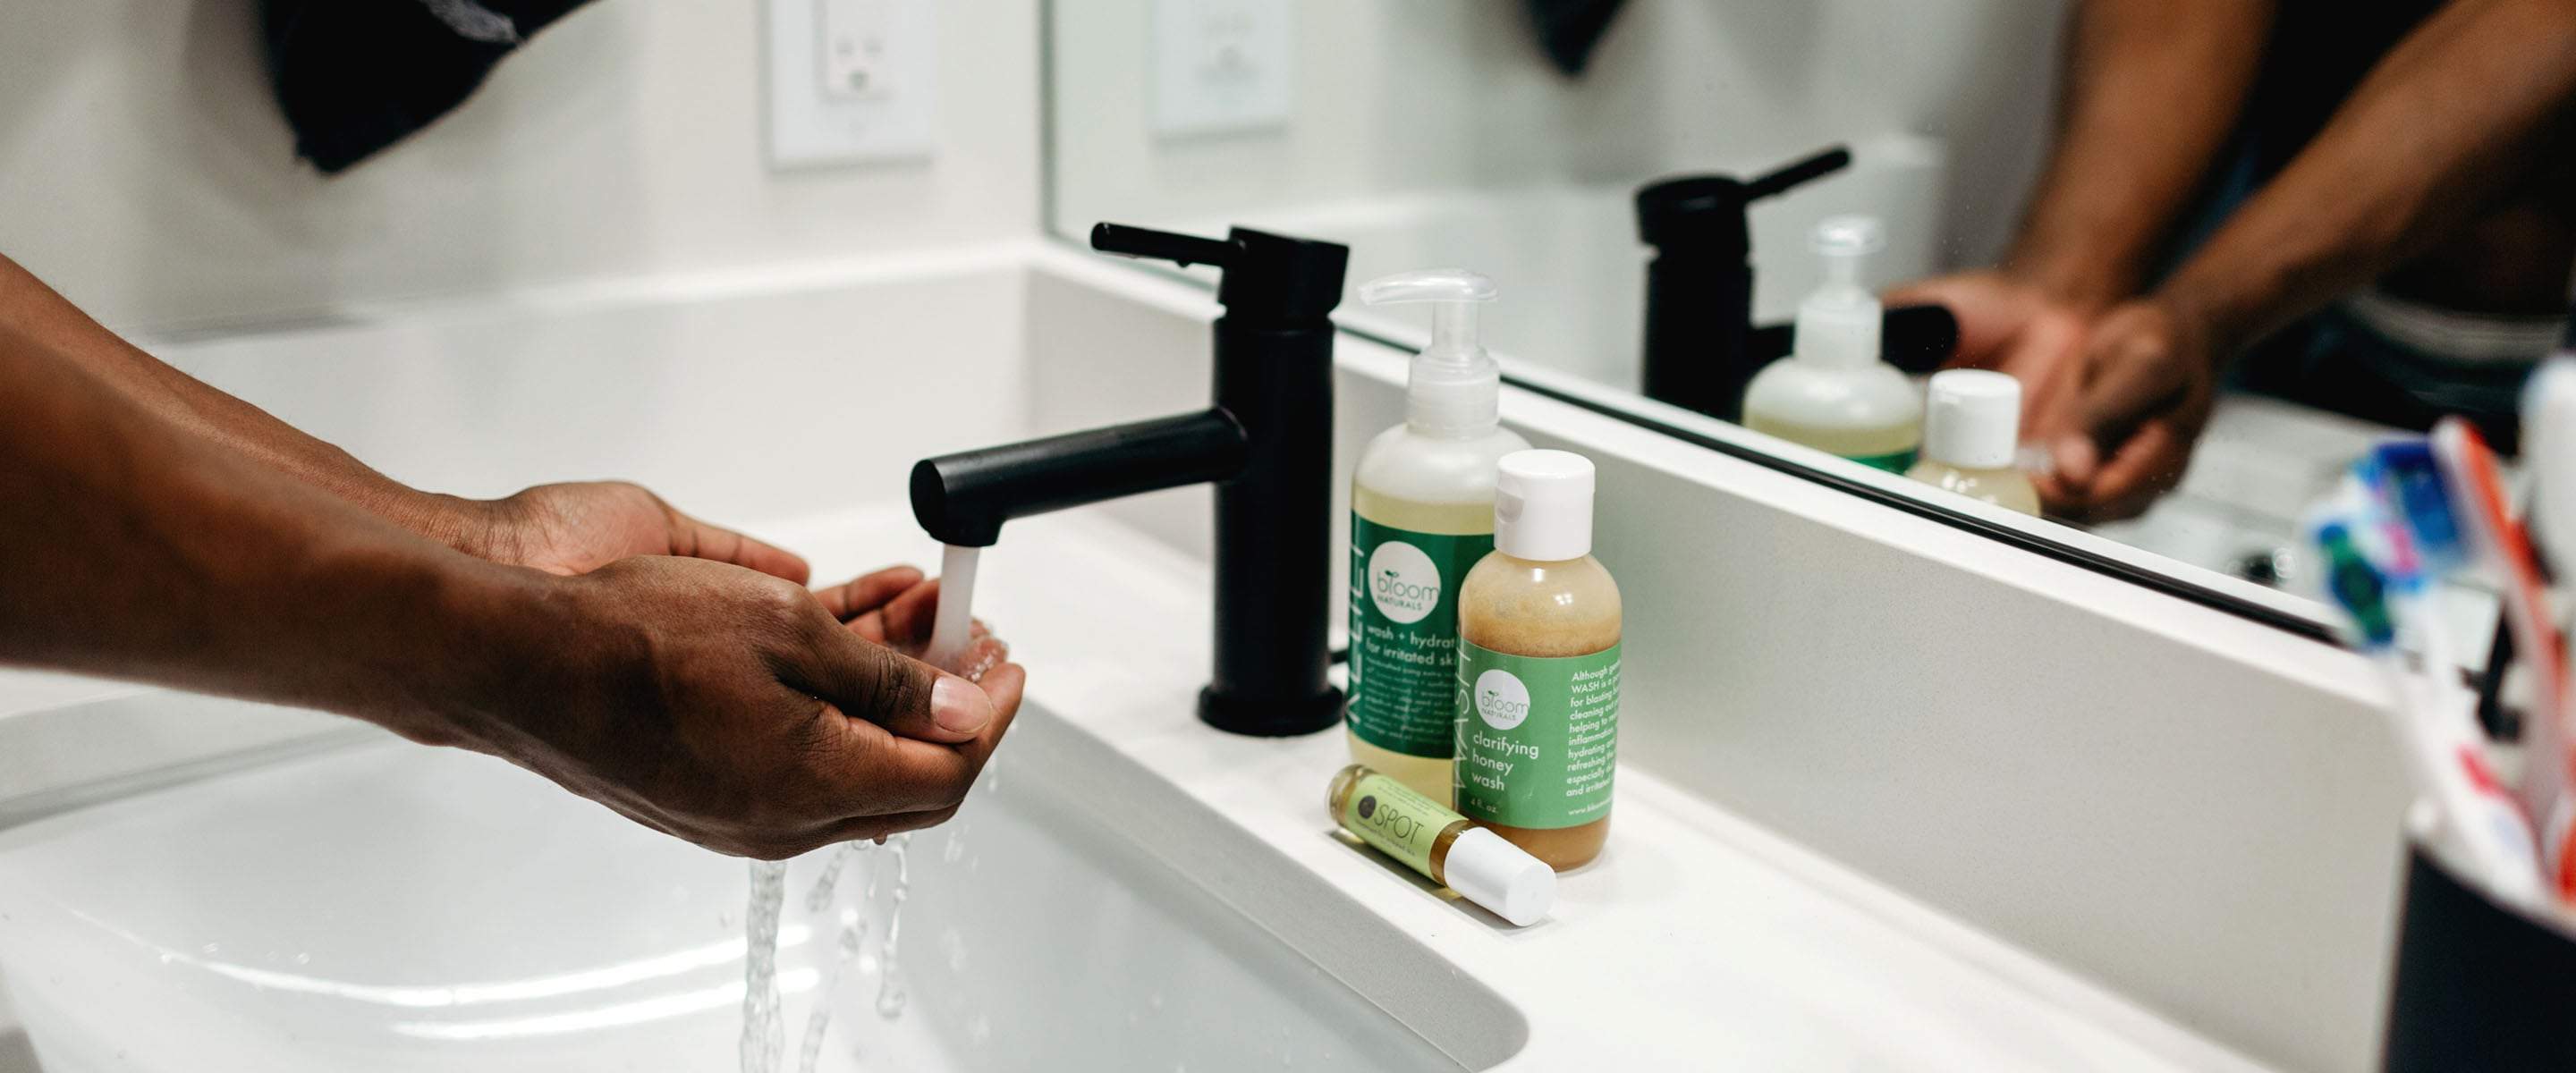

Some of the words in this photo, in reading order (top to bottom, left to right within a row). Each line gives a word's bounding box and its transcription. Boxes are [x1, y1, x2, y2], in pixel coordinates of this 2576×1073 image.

[1377, 570, 1439, 601] bloom
[1377, 595, 1423, 611] NATURALS
[1367, 626, 1394, 641] wash
[1410, 631, 1455, 650] hydrat
[1366, 638, 1381, 655] for
[1383, 644, 1436, 666] irritated
[1440, 654, 1454, 667] sk
[1572, 665, 1608, 681] Although
[1571, 680, 1599, 694] WASH
[1481, 690, 1530, 715] bloom
[1570, 697, 1584, 708] for
[1586, 690, 1612, 705] blasting
[1481, 707, 1517, 722] NATURALS
[1569, 707, 1604, 721] cleaning
[1568, 727, 1614, 746] inflammation
[1569, 721, 1600, 734] helping
[1473, 730, 1539, 760] clarifying
[1568, 744, 1606, 761] hydrating
[1472, 749, 1513, 777] honey
[1567, 756, 1606, 772] refreshing
[1471, 772, 1505, 791] wash
[1566, 766, 1605, 786] especially
[1566, 784, 1584, 797] and
[1373, 804, 1424, 845] SPOT
